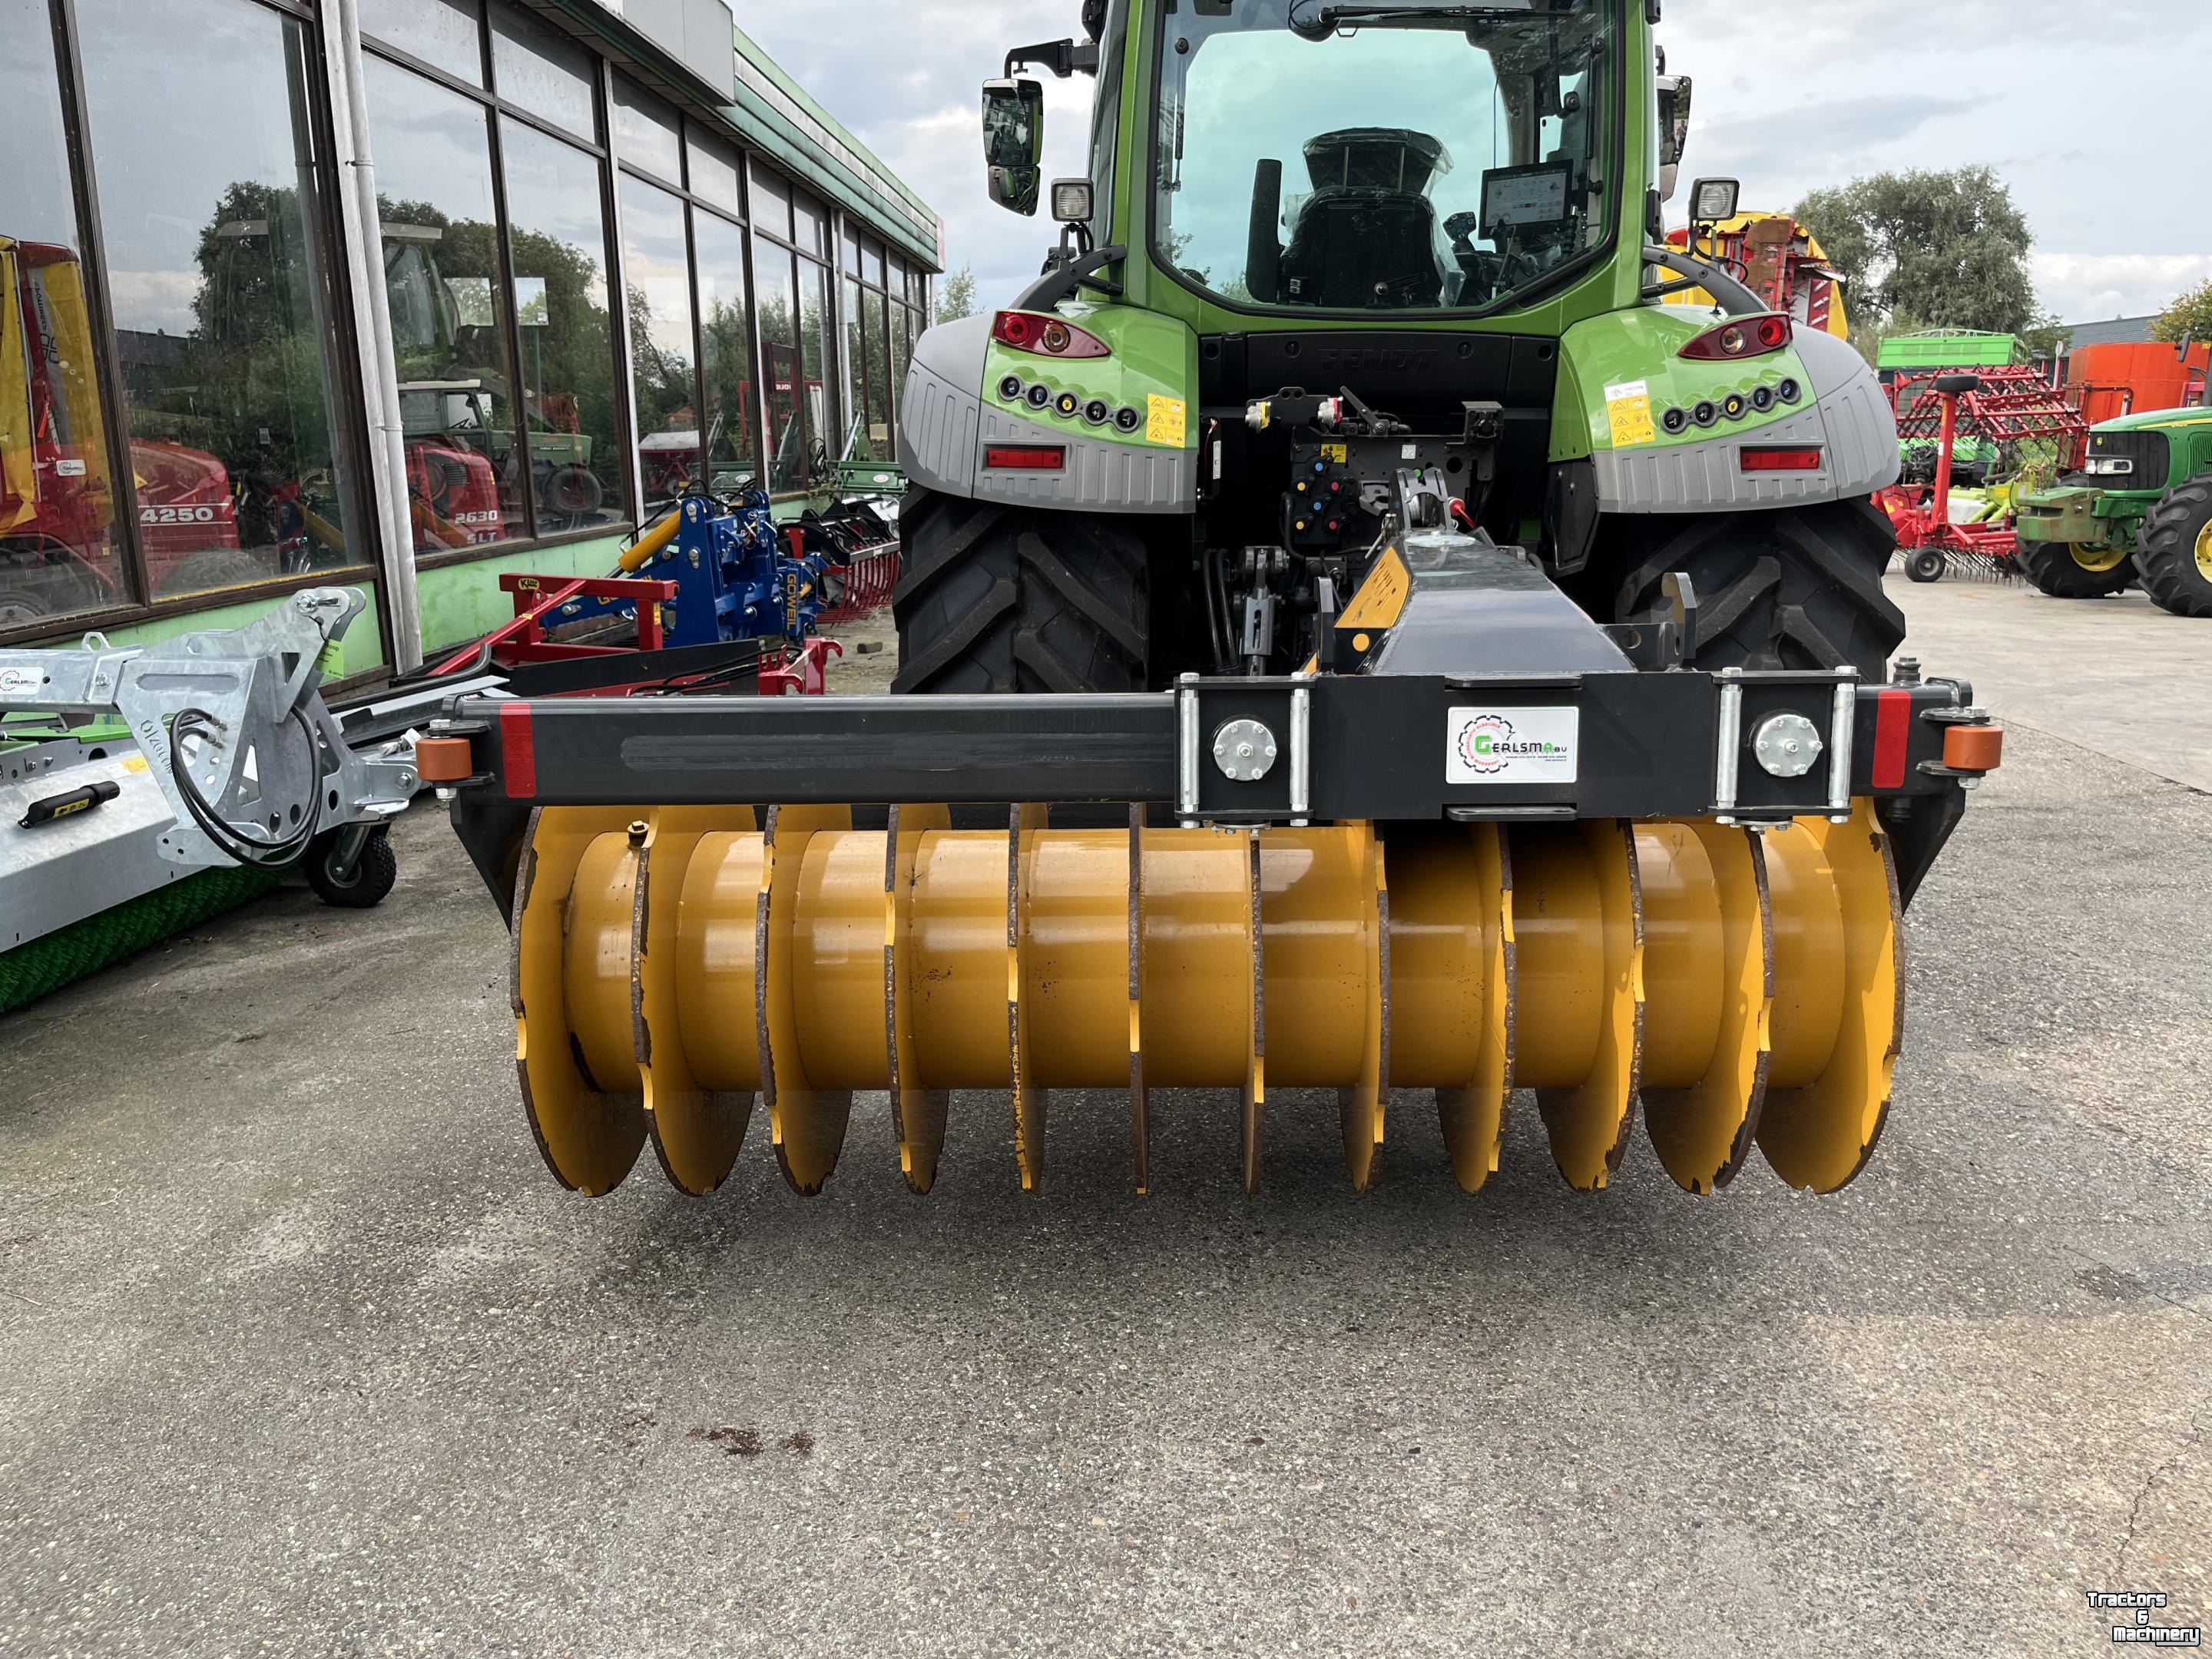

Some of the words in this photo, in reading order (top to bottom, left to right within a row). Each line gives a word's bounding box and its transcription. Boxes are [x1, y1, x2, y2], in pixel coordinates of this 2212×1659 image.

[1318, 348, 1439, 373] FENDT
[140, 507, 214, 522] 4250
[455, 510, 498, 524] 2630
[467, 532, 497, 544] SLT
